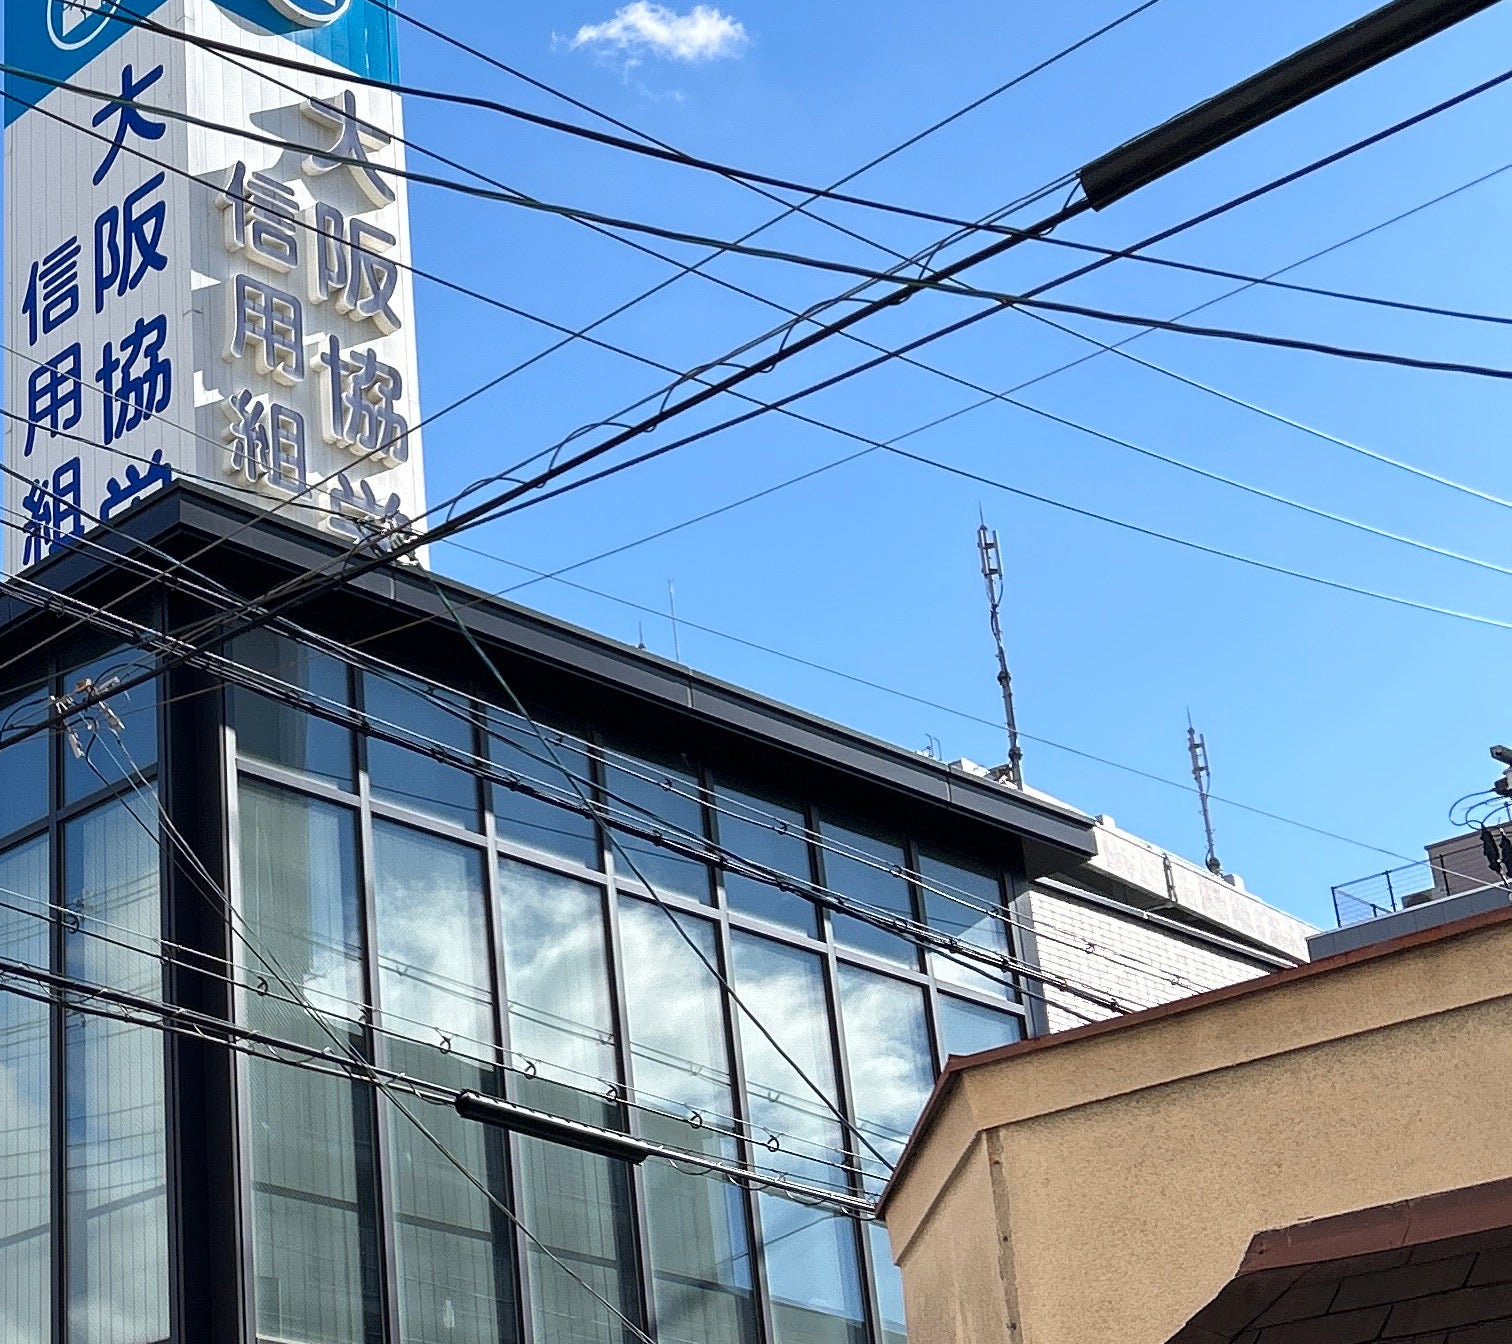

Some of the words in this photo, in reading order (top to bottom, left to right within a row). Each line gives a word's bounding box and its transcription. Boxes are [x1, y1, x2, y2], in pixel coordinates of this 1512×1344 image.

[21, 234, 86, 565] 信用組
[219, 160, 312, 499] 信用組
